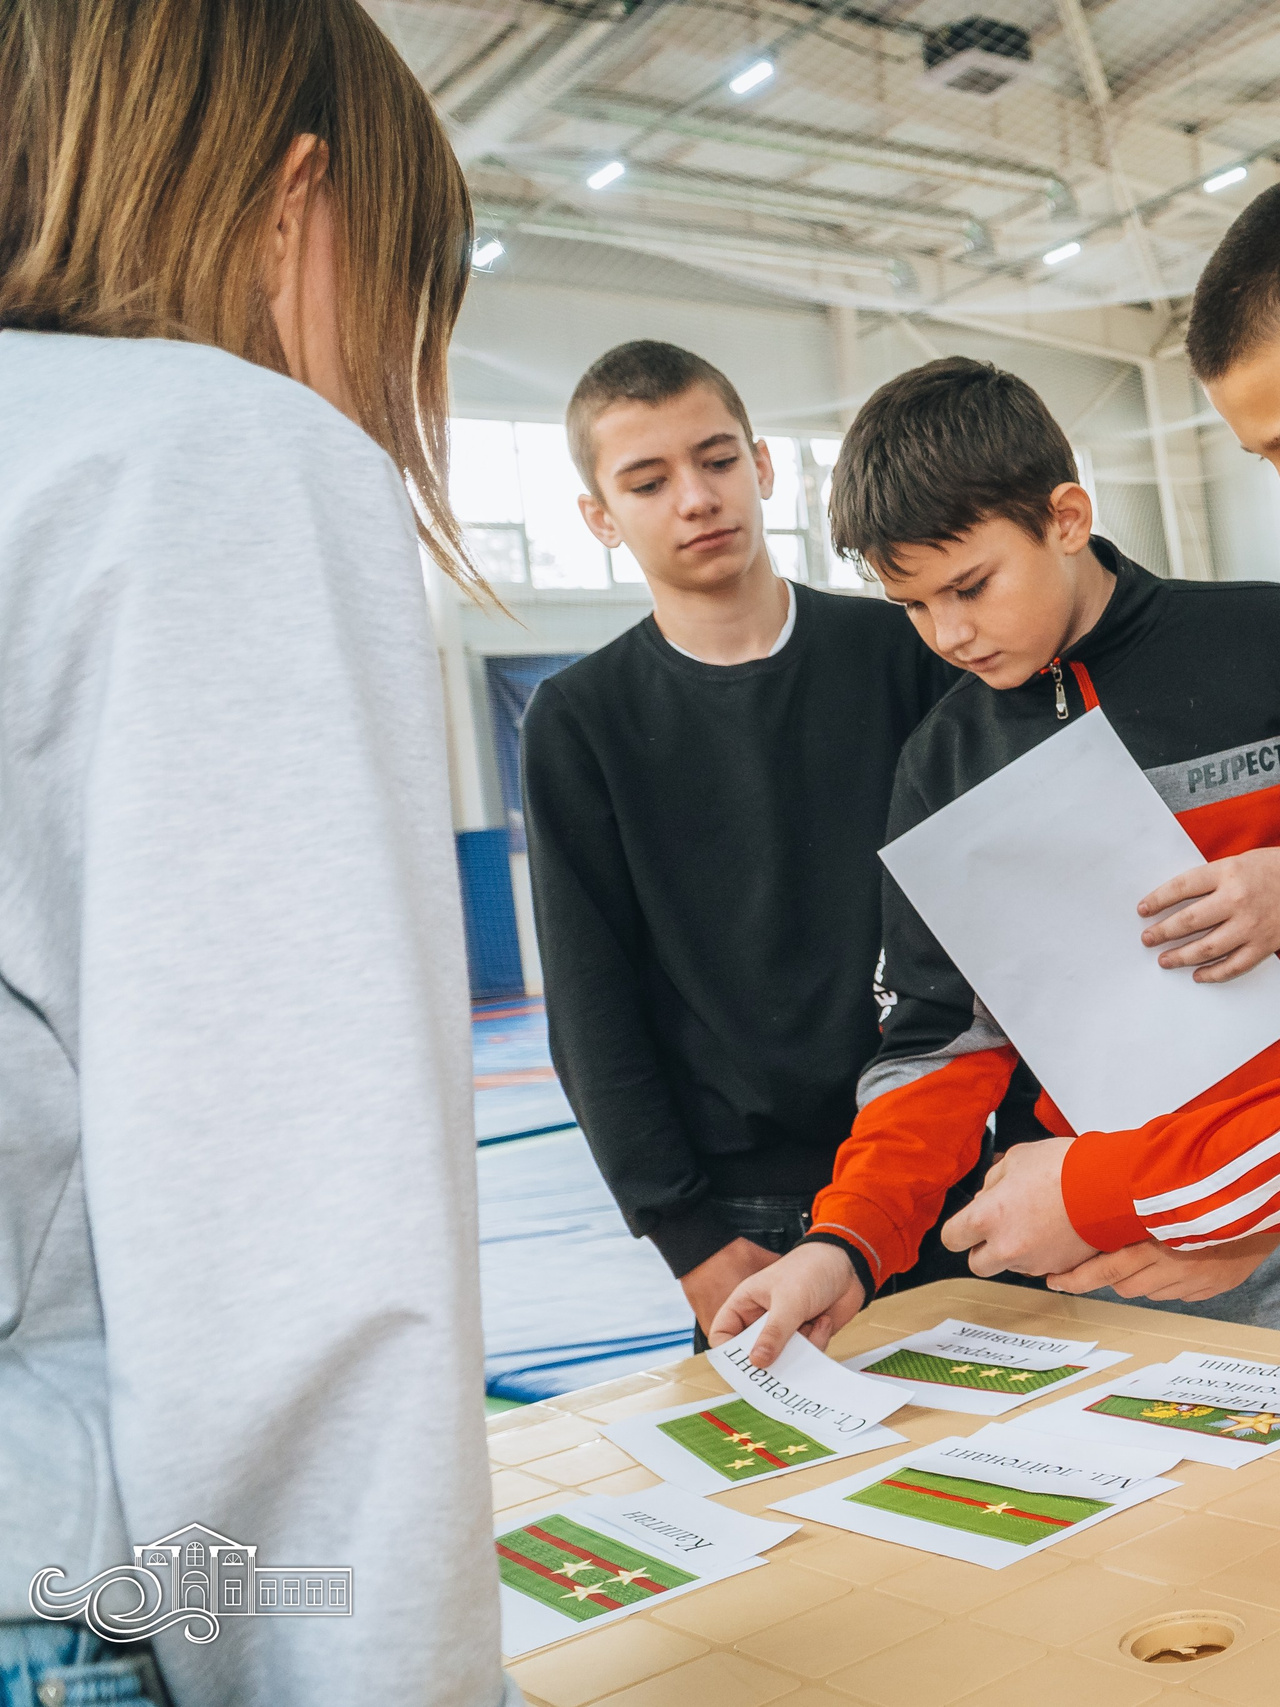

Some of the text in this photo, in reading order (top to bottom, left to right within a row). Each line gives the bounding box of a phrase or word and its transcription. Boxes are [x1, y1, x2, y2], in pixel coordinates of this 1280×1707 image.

[952, 1326, 1069, 1354] полковник
[723, 1346, 867, 1434] Ст. лейтенант
[1161, 1389, 1279, 1411] Маршал
[940, 1447, 1142, 1489] Мл. лейтенант
[621, 1510, 714, 1552] Капитан
